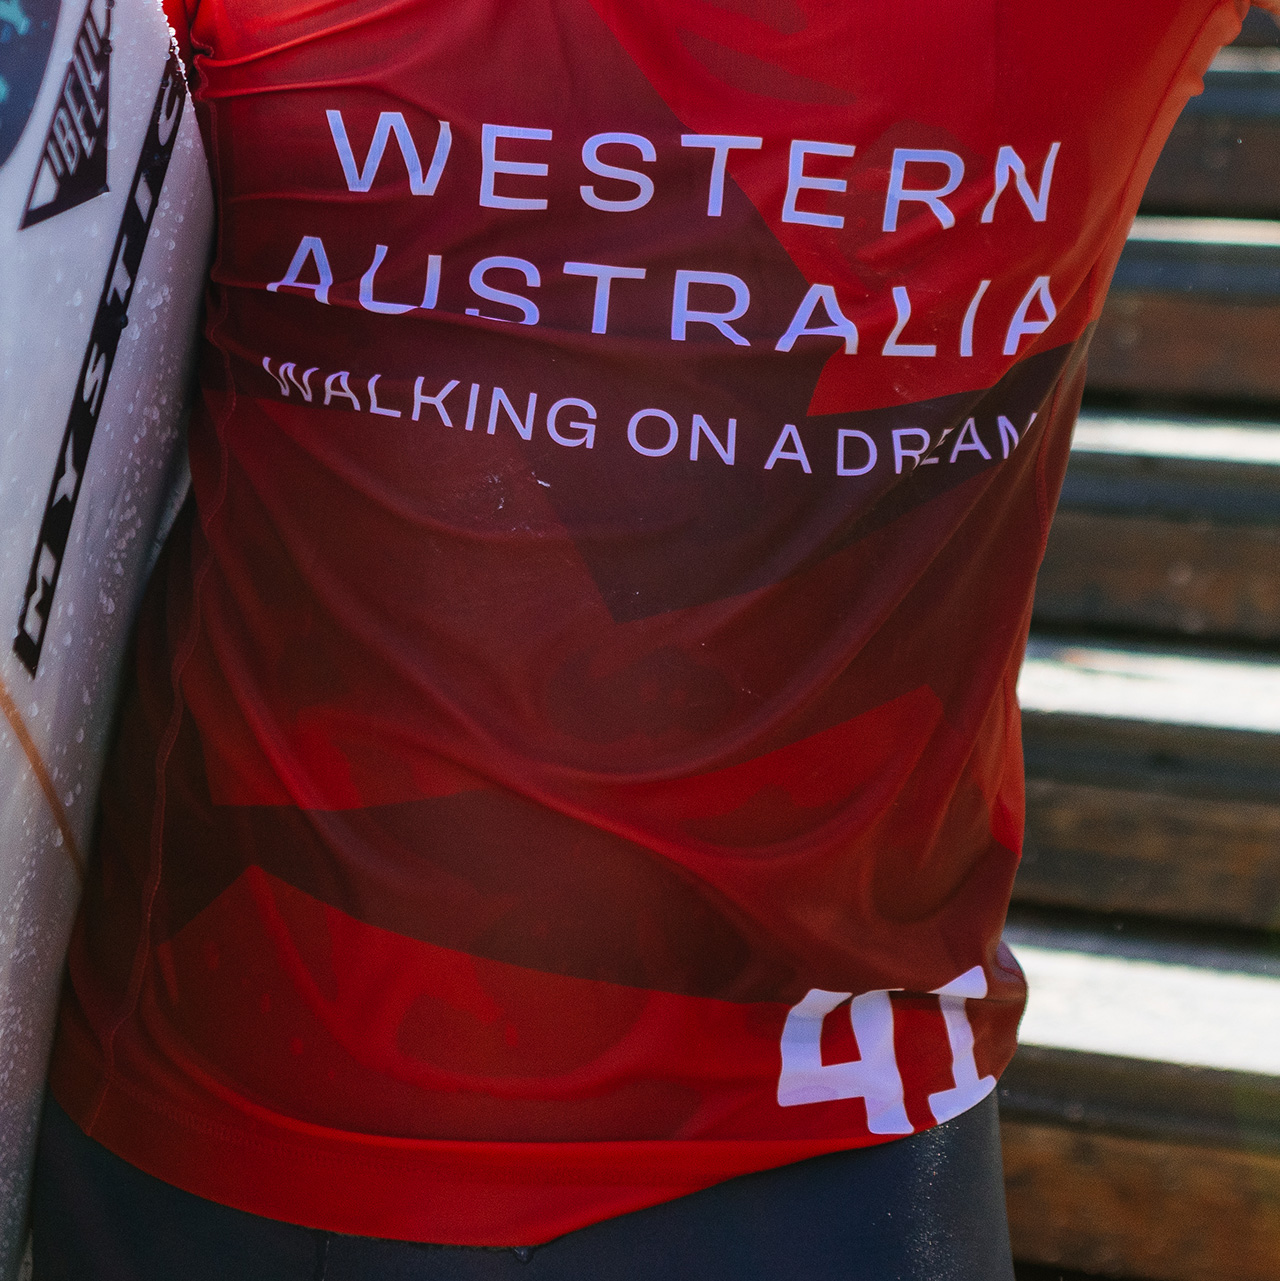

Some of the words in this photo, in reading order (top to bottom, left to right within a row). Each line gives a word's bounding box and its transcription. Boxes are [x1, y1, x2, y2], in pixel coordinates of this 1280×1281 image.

[325, 109, 1061, 232] WESTERN
[23, 73, 181, 643] MYSTIC
[266, 235, 1058, 358] AUSTRALIA
[262, 356, 596, 449] WALKING
[627, 408, 737, 467] ON
[764, 423, 812, 474] A
[777, 965, 997, 1135] 41
